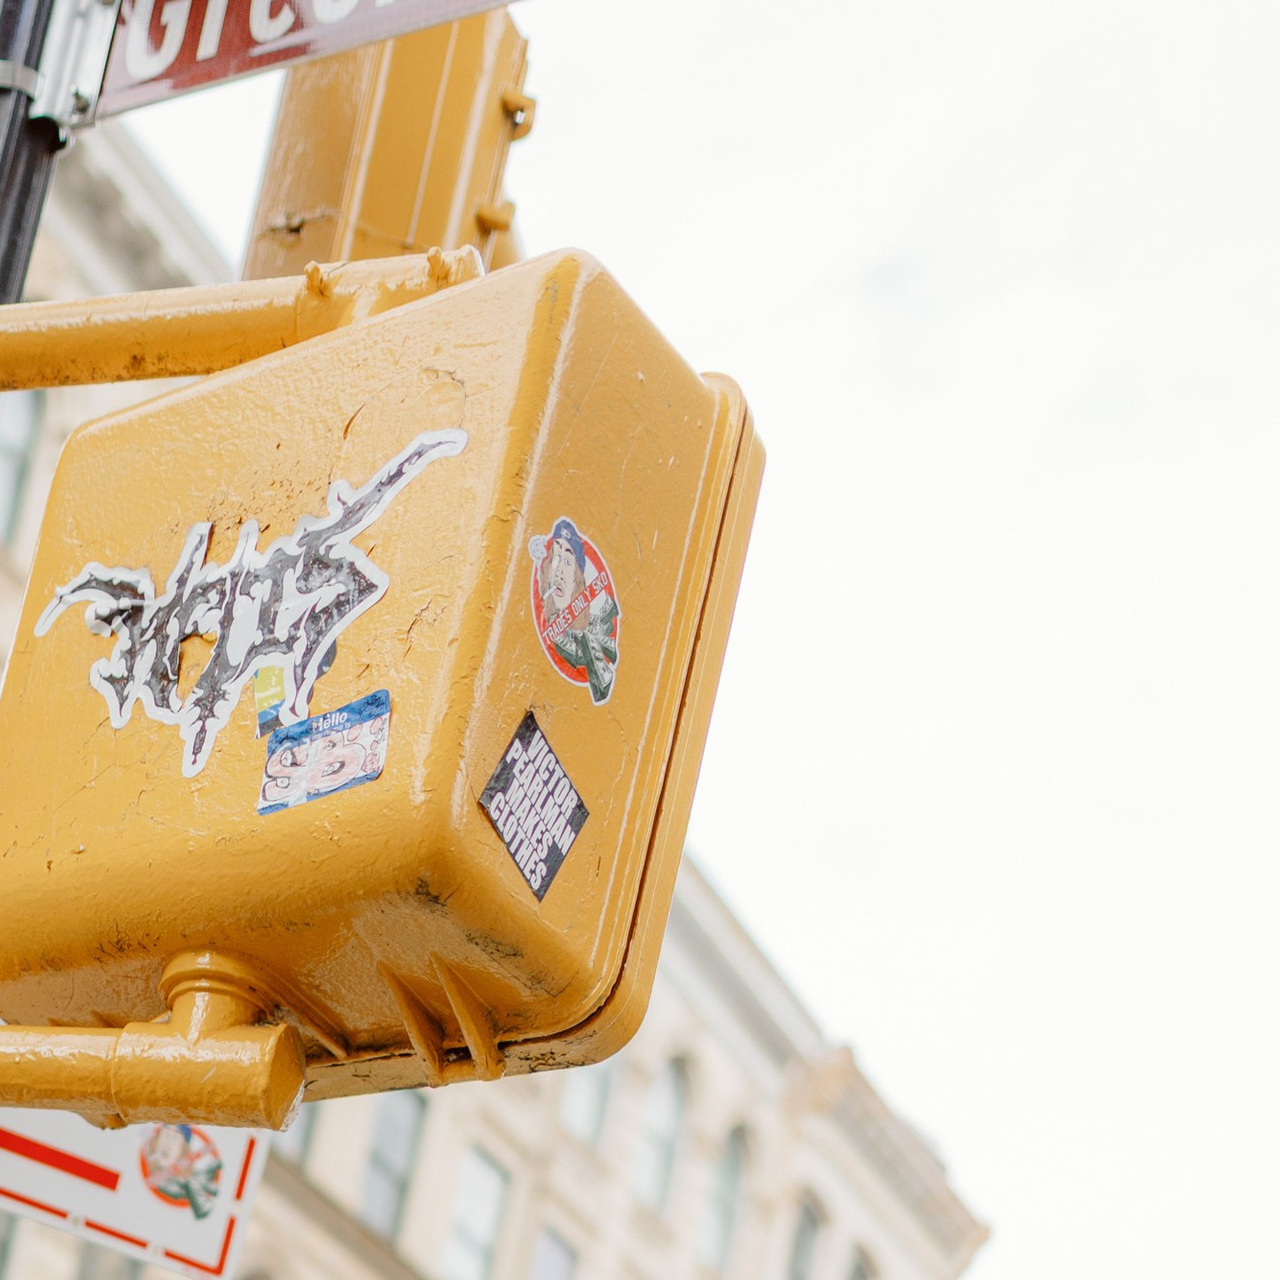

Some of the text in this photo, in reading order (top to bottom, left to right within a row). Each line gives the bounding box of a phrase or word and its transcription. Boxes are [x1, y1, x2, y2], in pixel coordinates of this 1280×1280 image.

[542, 609, 574, 645] TRADES
[572, 585, 595, 617] ONLY
[505, 778, 554, 860] MAKES
[506, 738, 577, 857] PEARLMAN
[527, 729, 579, 820] VICTOR
[489, 791, 548, 890] CLOTHES
